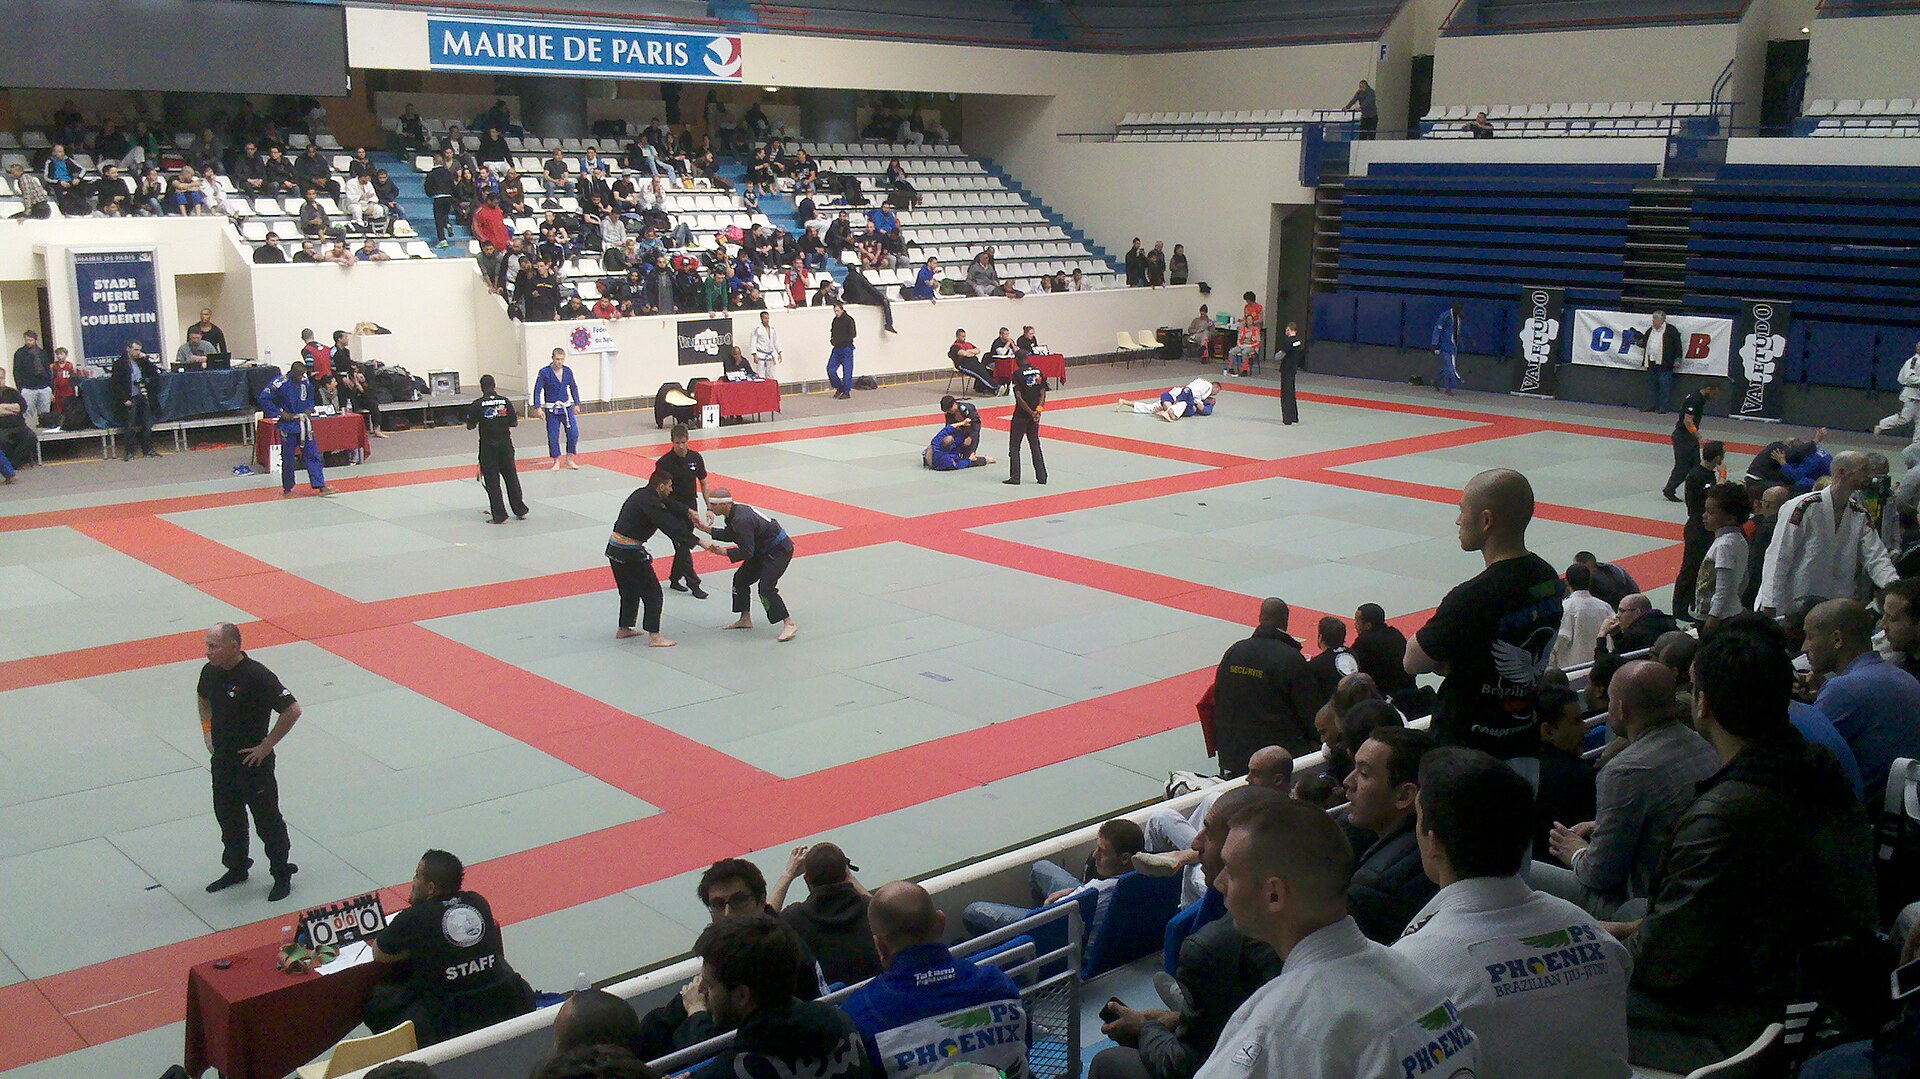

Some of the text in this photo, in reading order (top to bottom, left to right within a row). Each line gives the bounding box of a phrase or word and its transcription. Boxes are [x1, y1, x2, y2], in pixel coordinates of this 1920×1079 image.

[443, 29, 689, 67] MAIRIE DE PARIS
[1380, 44, 1387, 60] F
[94, 278, 137, 290] STADE
[92, 290, 140, 302] PIERRE
[108, 302, 127, 313] DE
[81, 312, 156, 326] COUBERTIN
[706, 412, 714, 424] 4
[1567, 924, 1597, 944] PS
[445, 954, 496, 981] STAFF
[1485, 942, 1606, 984] PHOENIX
[1493, 972, 1562, 998] BRAZILIAN
[990, 1003, 1021, 1023] PS
[894, 1024, 1021, 1071] PHOENIX
